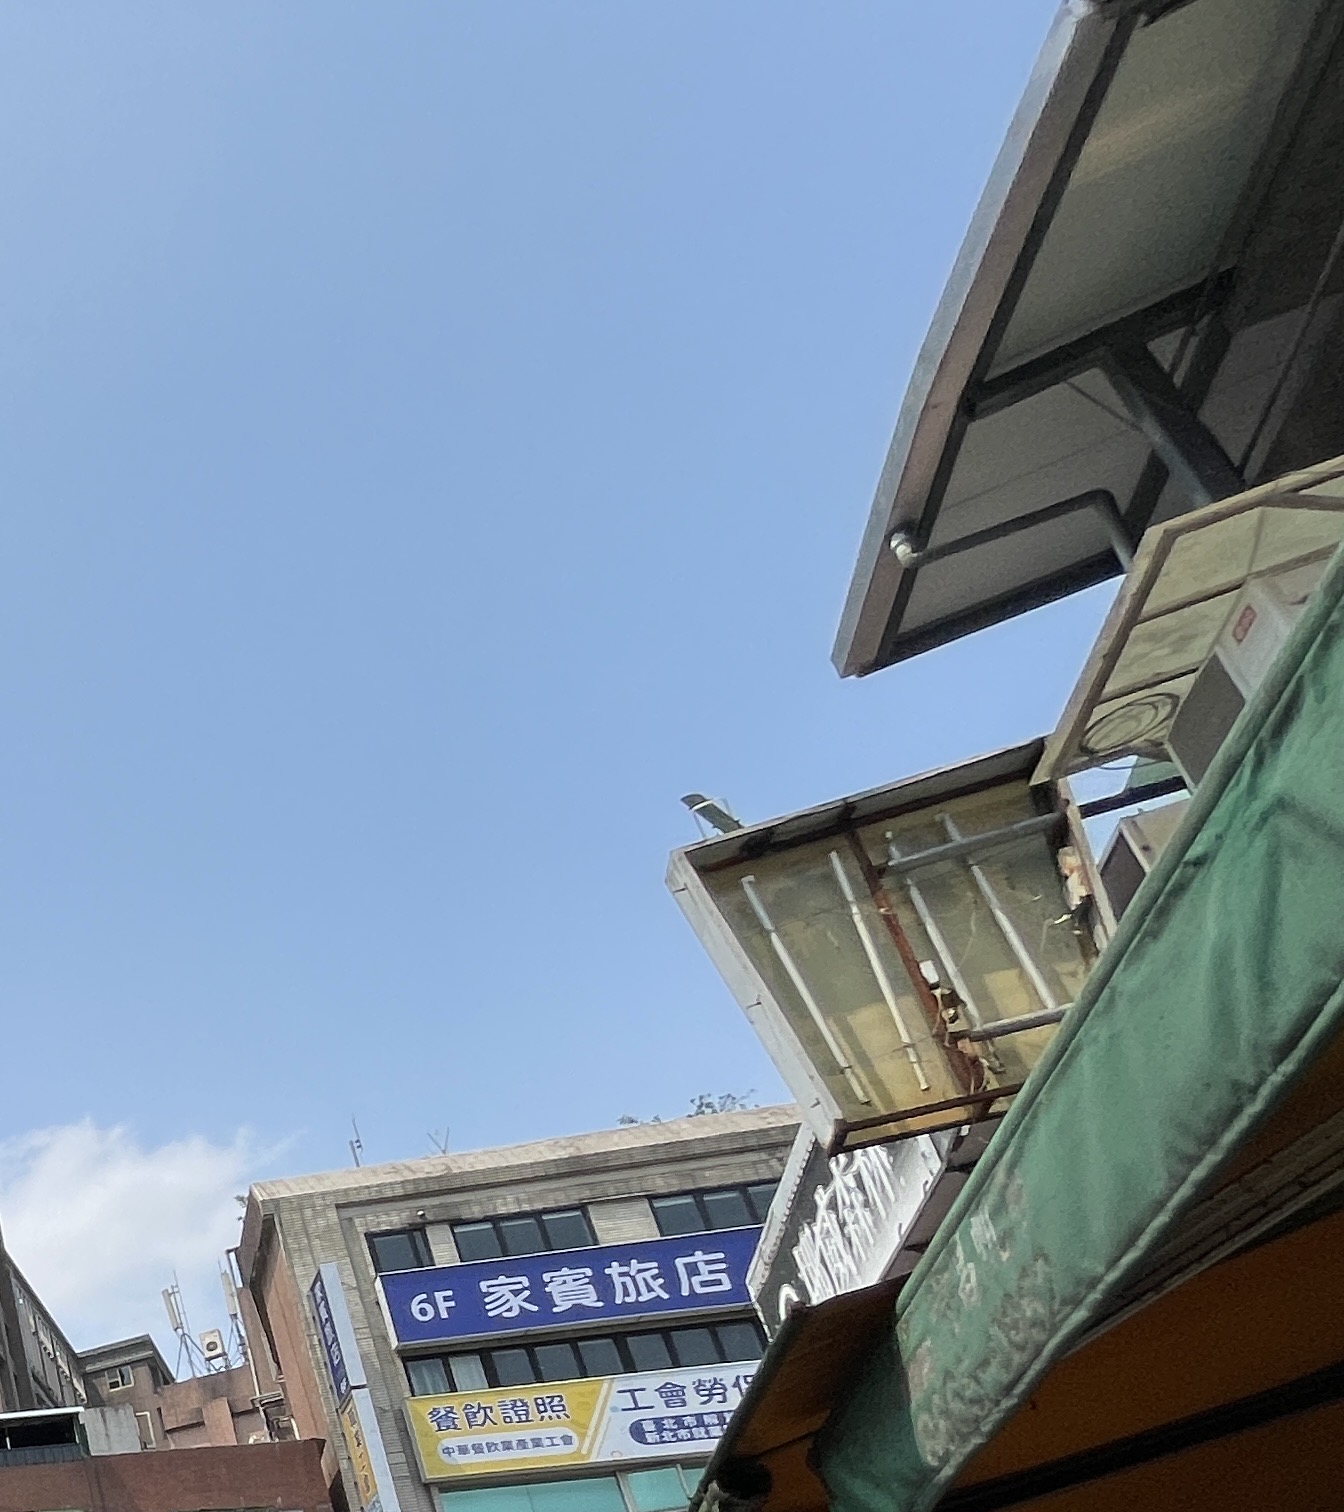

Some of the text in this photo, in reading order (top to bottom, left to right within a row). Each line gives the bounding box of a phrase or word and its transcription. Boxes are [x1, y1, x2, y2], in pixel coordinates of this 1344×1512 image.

[410, 1249, 732, 1323] 6F 家賓旅店
[428, 1394, 571, 1433] 餐飲證照
